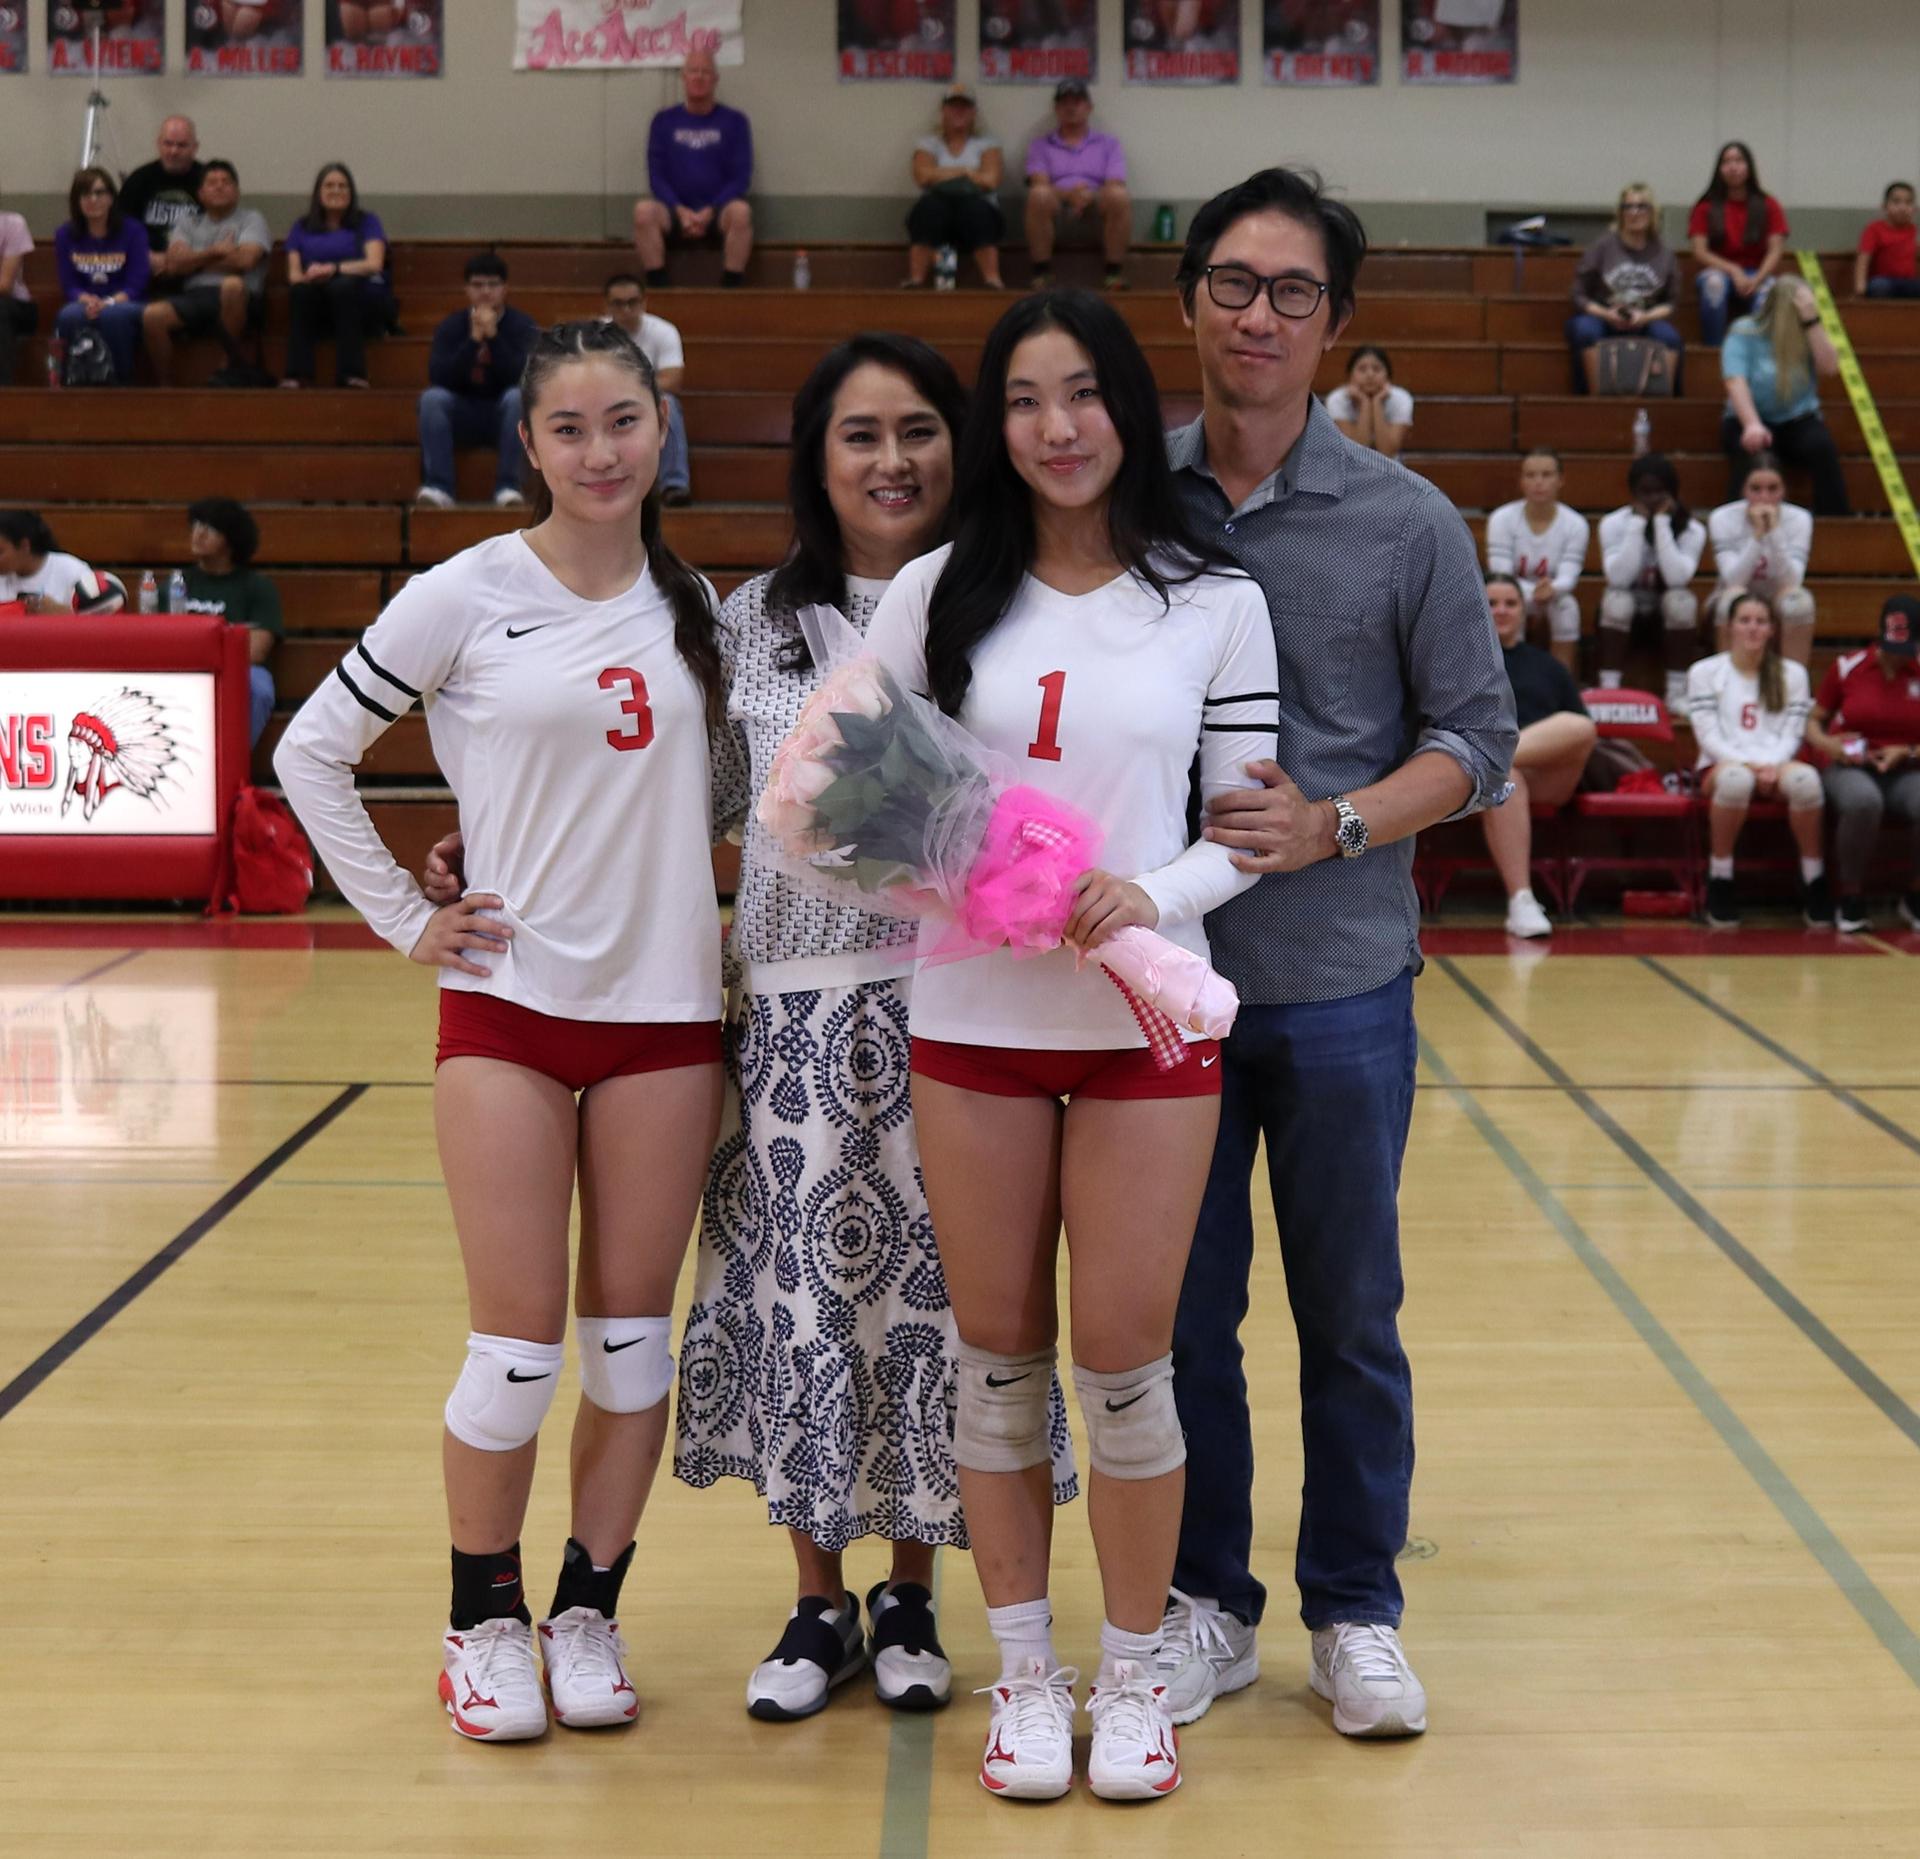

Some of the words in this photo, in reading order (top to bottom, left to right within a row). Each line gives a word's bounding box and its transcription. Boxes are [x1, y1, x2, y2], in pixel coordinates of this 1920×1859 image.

[1517, 554, 1550, 578] 14
[597, 666, 655, 752] 3
[1027, 669, 1067, 762] 1
[1740, 703, 1758, 730] 6
[9, 801, 53, 815] Wide
